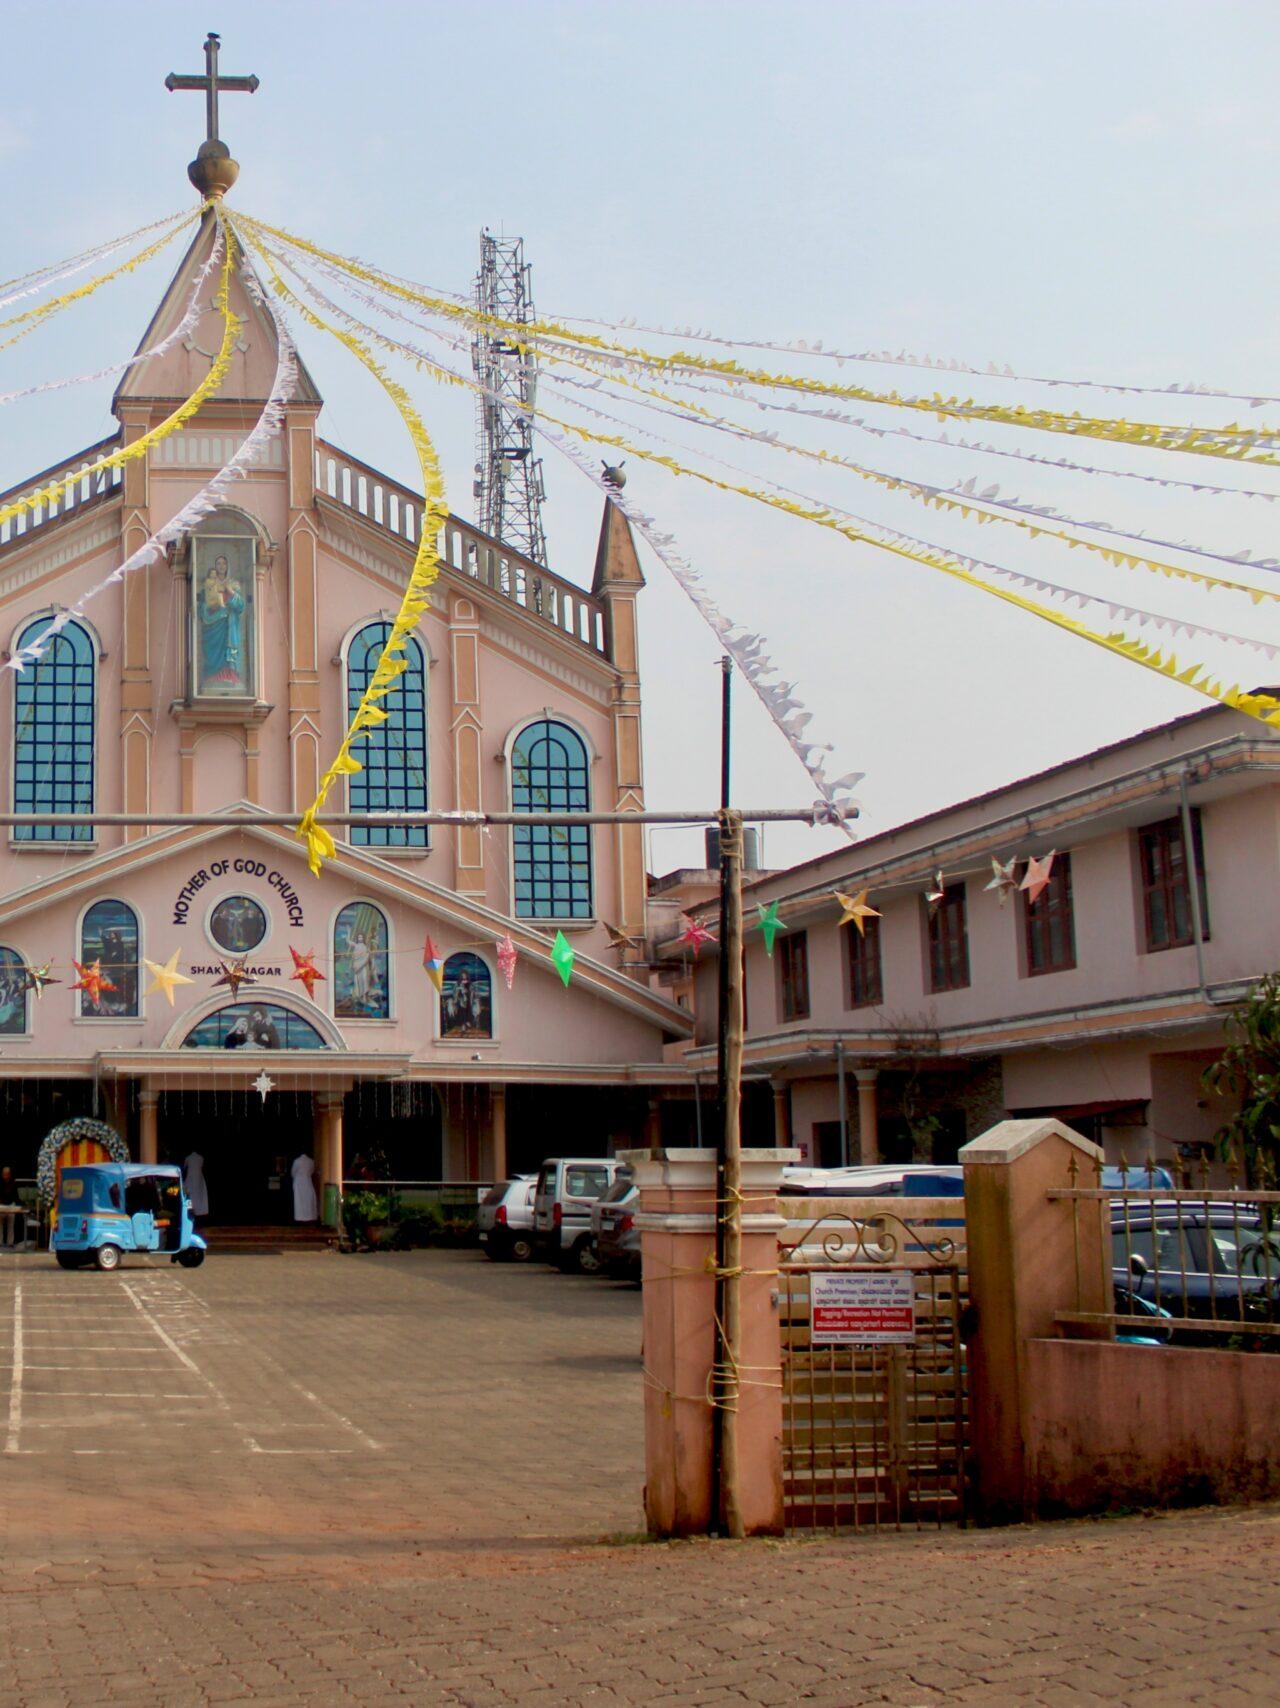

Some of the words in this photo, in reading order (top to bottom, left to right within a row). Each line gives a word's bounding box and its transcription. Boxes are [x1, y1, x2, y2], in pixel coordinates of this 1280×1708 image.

[173, 869, 211, 925] MOTHER
[210, 859, 230, 876] OF
[233, 858, 267, 877] GOD
[267, 871, 304, 927] CHURCH
